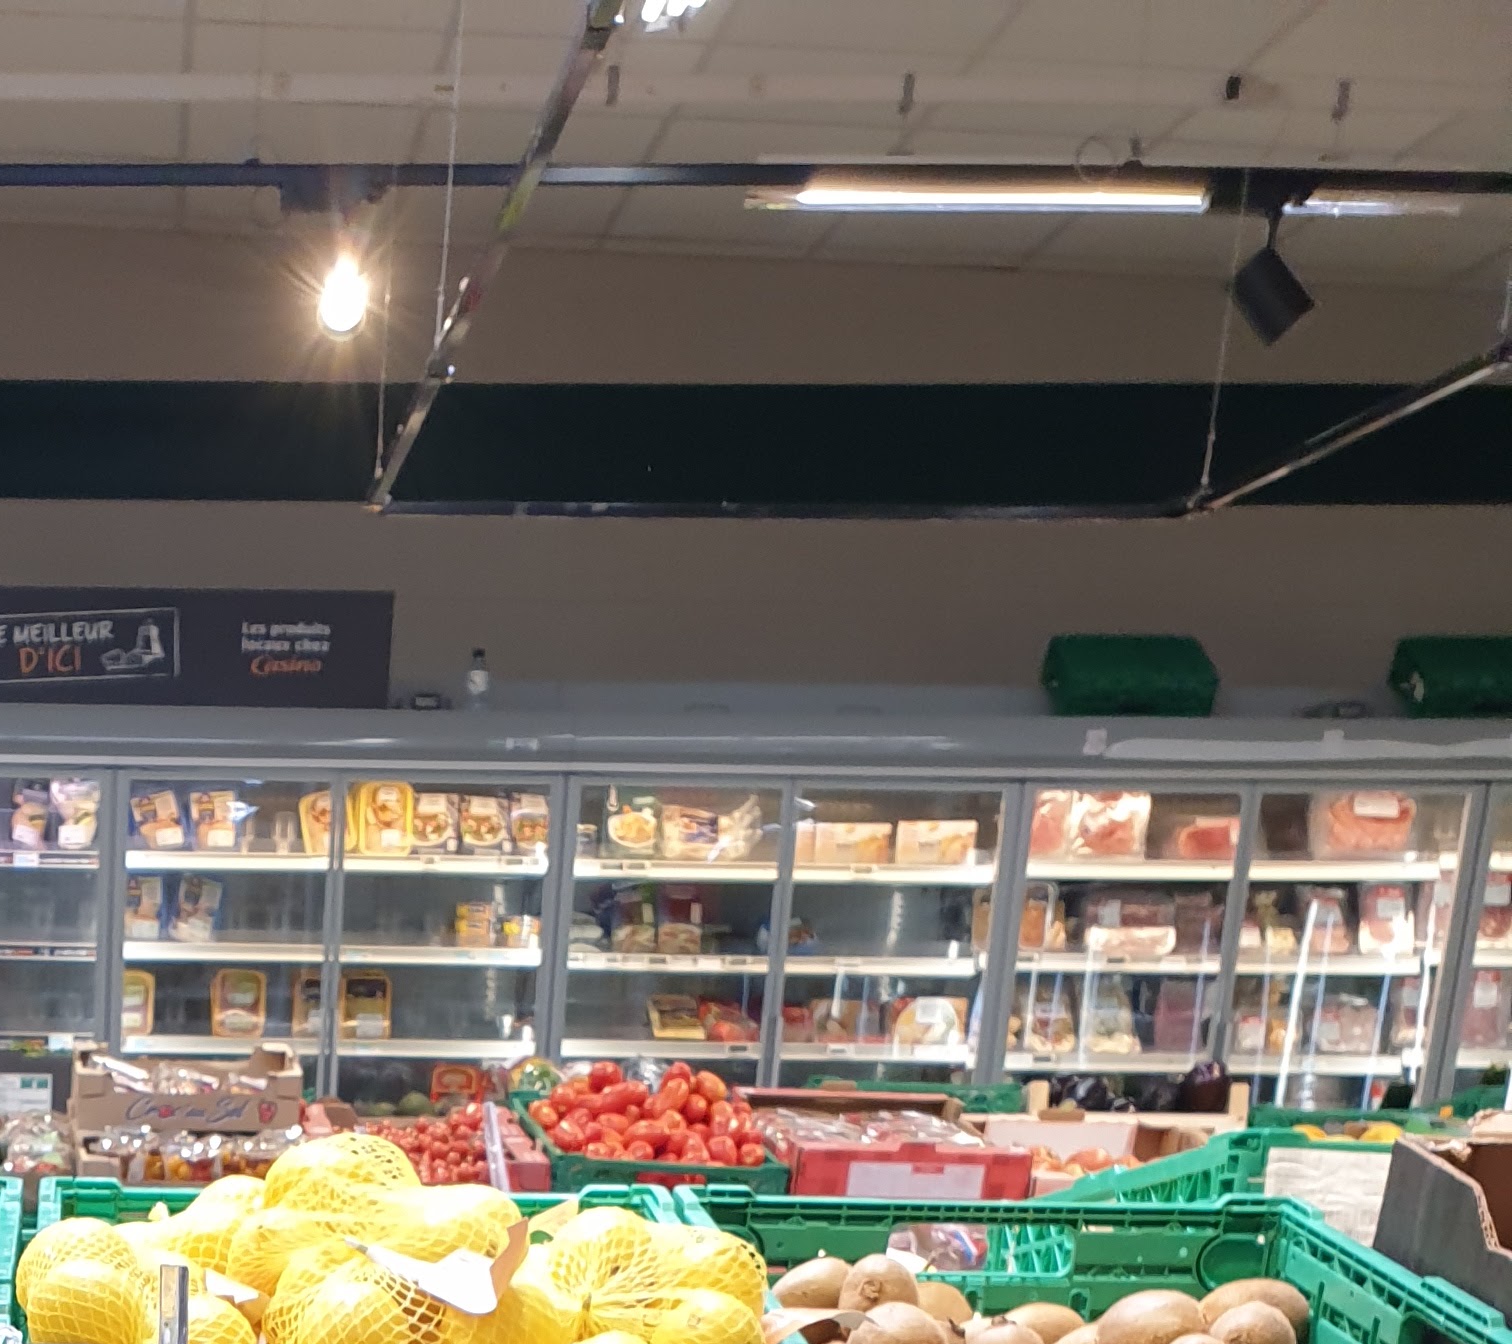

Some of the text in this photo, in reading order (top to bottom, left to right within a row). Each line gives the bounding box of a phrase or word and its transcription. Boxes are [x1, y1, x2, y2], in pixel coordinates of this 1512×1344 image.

[12, 620, 115, 643] MEILLEUR
[270, 621, 331, 637] produits
[19, 644, 82, 674] D'ICI
[250, 655, 322, 675] Casino
